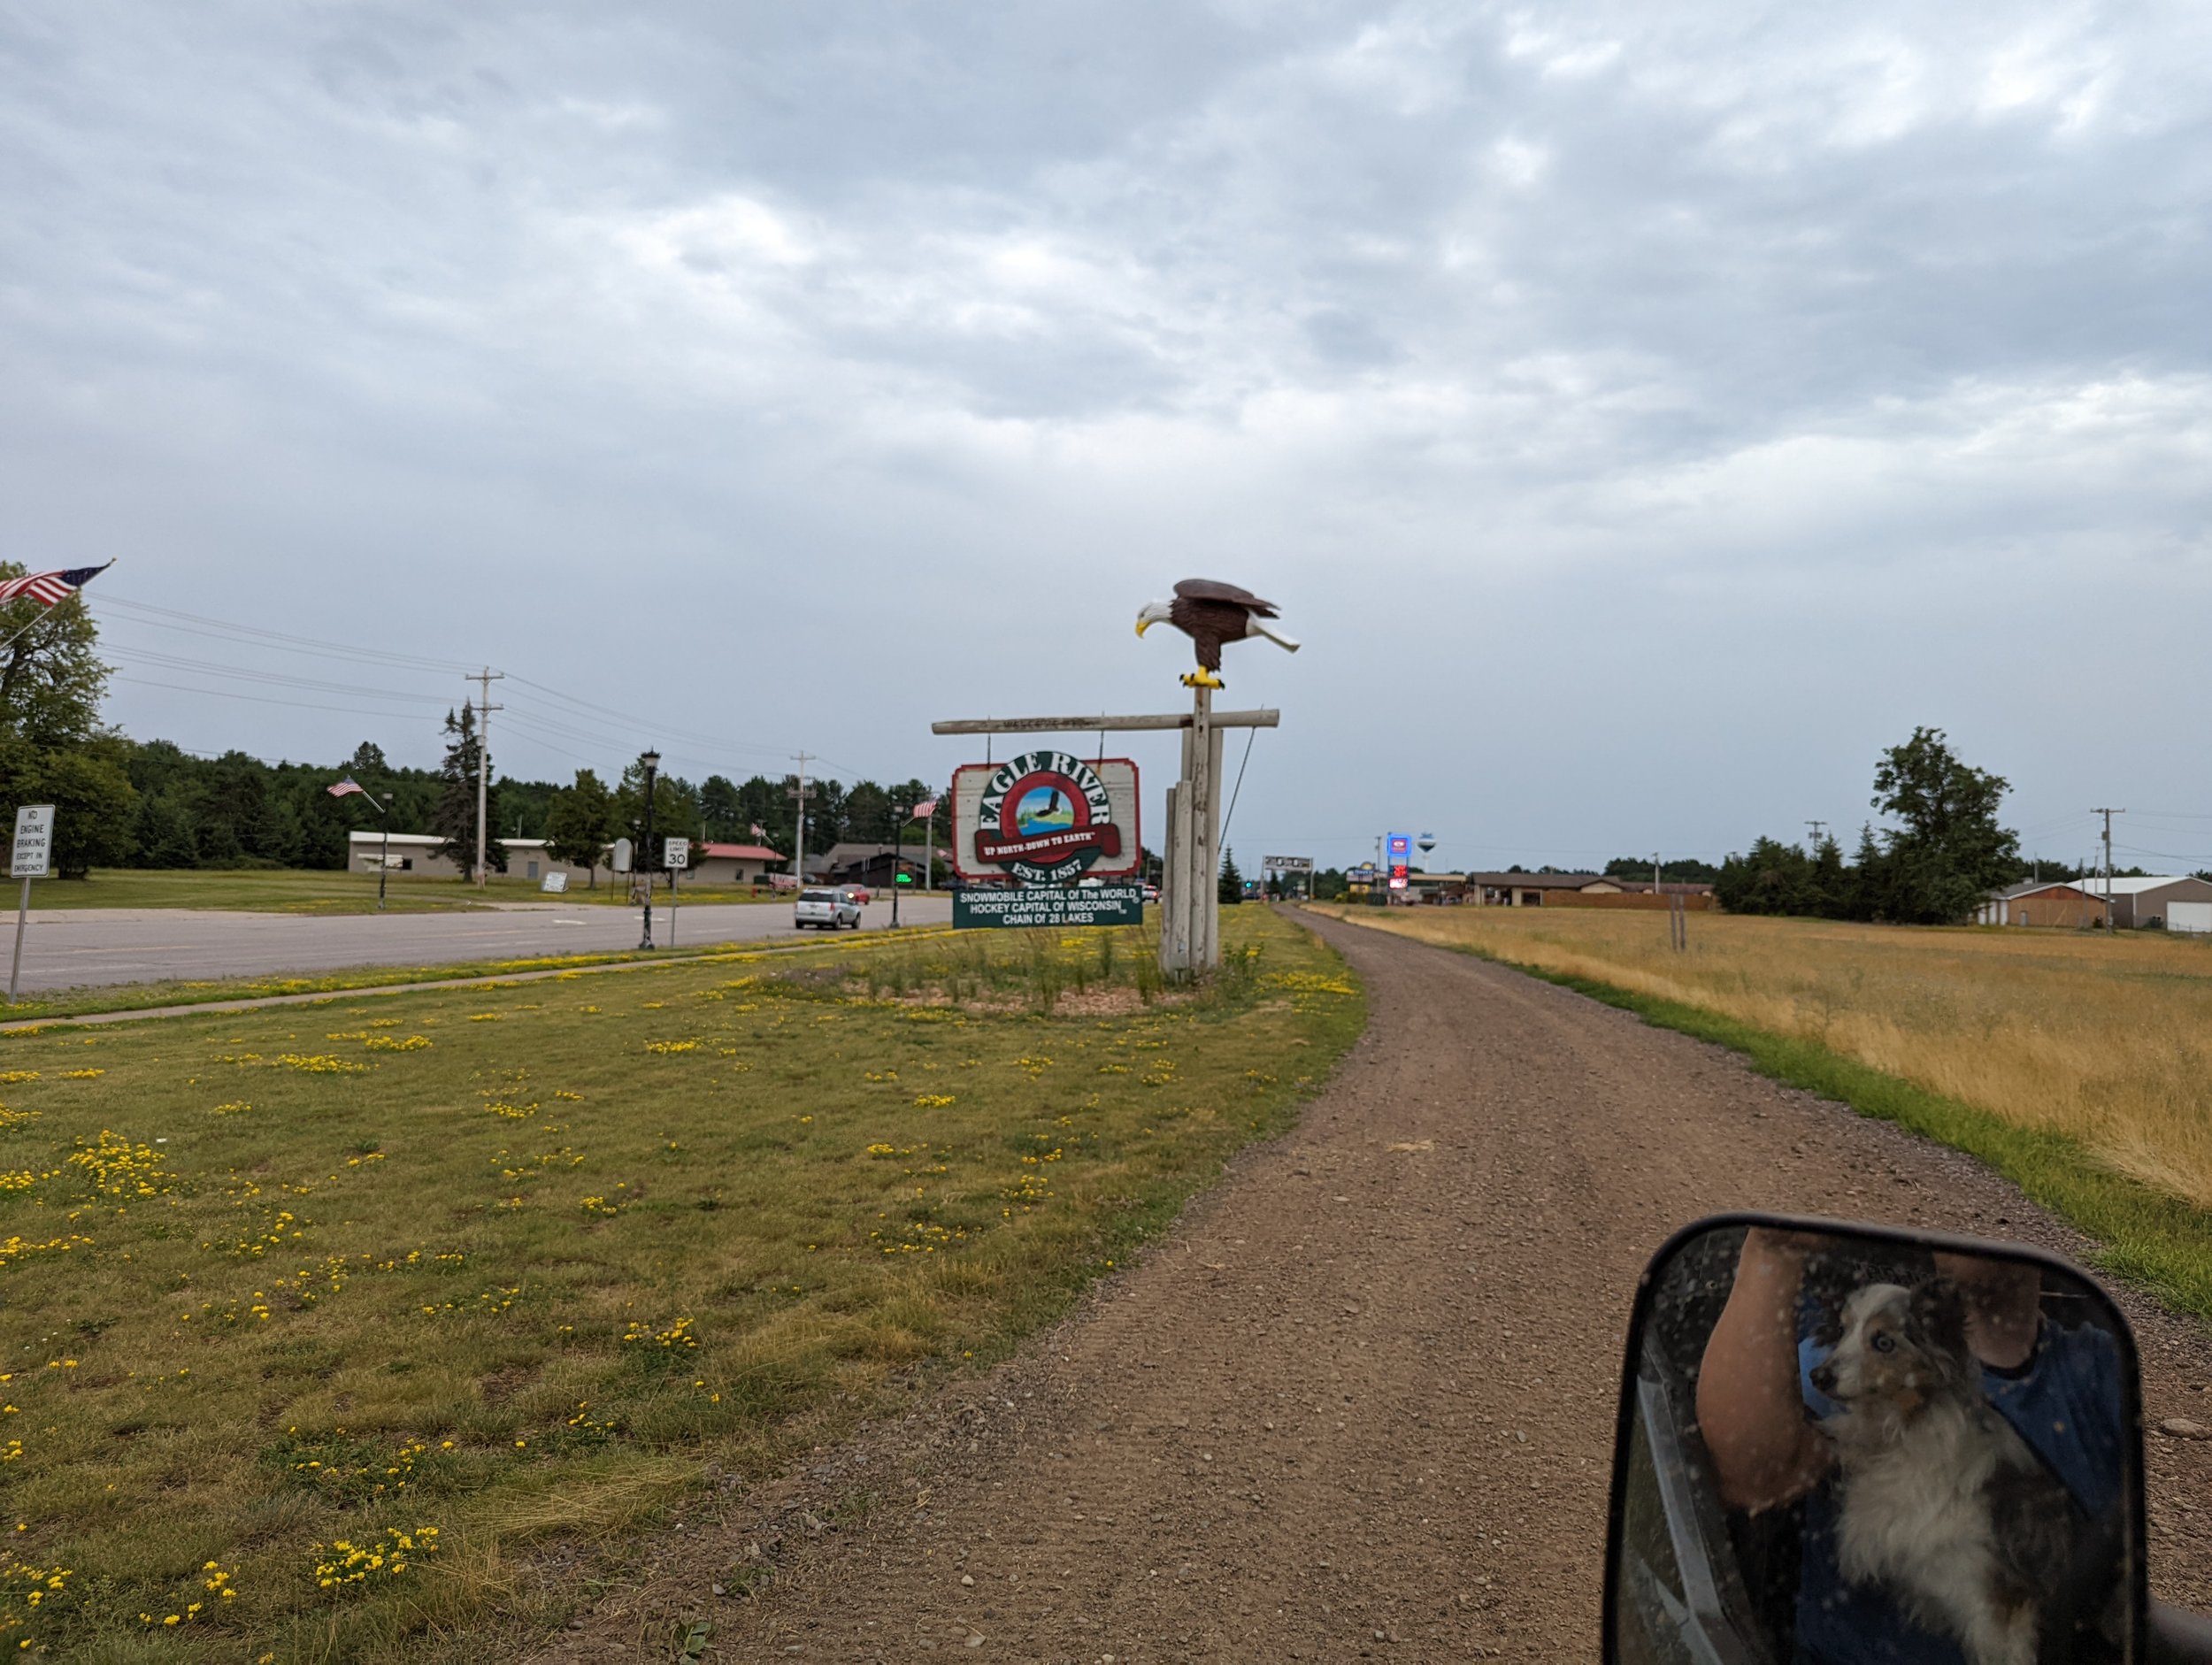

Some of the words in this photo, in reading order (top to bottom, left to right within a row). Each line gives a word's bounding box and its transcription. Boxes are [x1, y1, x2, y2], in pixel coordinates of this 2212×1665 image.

[980, 752, 1041, 830] EAGLE
[1049, 752, 1110, 825] RIVER
[27, 809, 38, 819] NO
[19, 824, 44, 834] ENGINE
[16, 838, 46, 848] BRAKING
[984, 847, 995, 856] UP
[1051, 836, 1063, 846] TO
[1064, 832, 1091, 844] EARTH
[668, 853, 686, 864] 30
[1011, 862, 1046, 881] EST.
[1050, 858, 1082, 881] 1857
[960, 891, 1025, 903] SNOWMOBILE
[1026, 890, 1066, 902] CAPITAL
[1081, 888, 1098, 900] The
[1100, 887, 1137, 899] WORLD
[970, 902, 1010, 914] HOCKEY
[1011, 902, 1051, 912] CAPITAL
[1067, 899, 1122, 911] WISCONSIN
[1002, 914, 1033, 925] CHAIN
[1048, 913, 1061, 924] 28
[1062, 912, 1094, 924] LAKES
